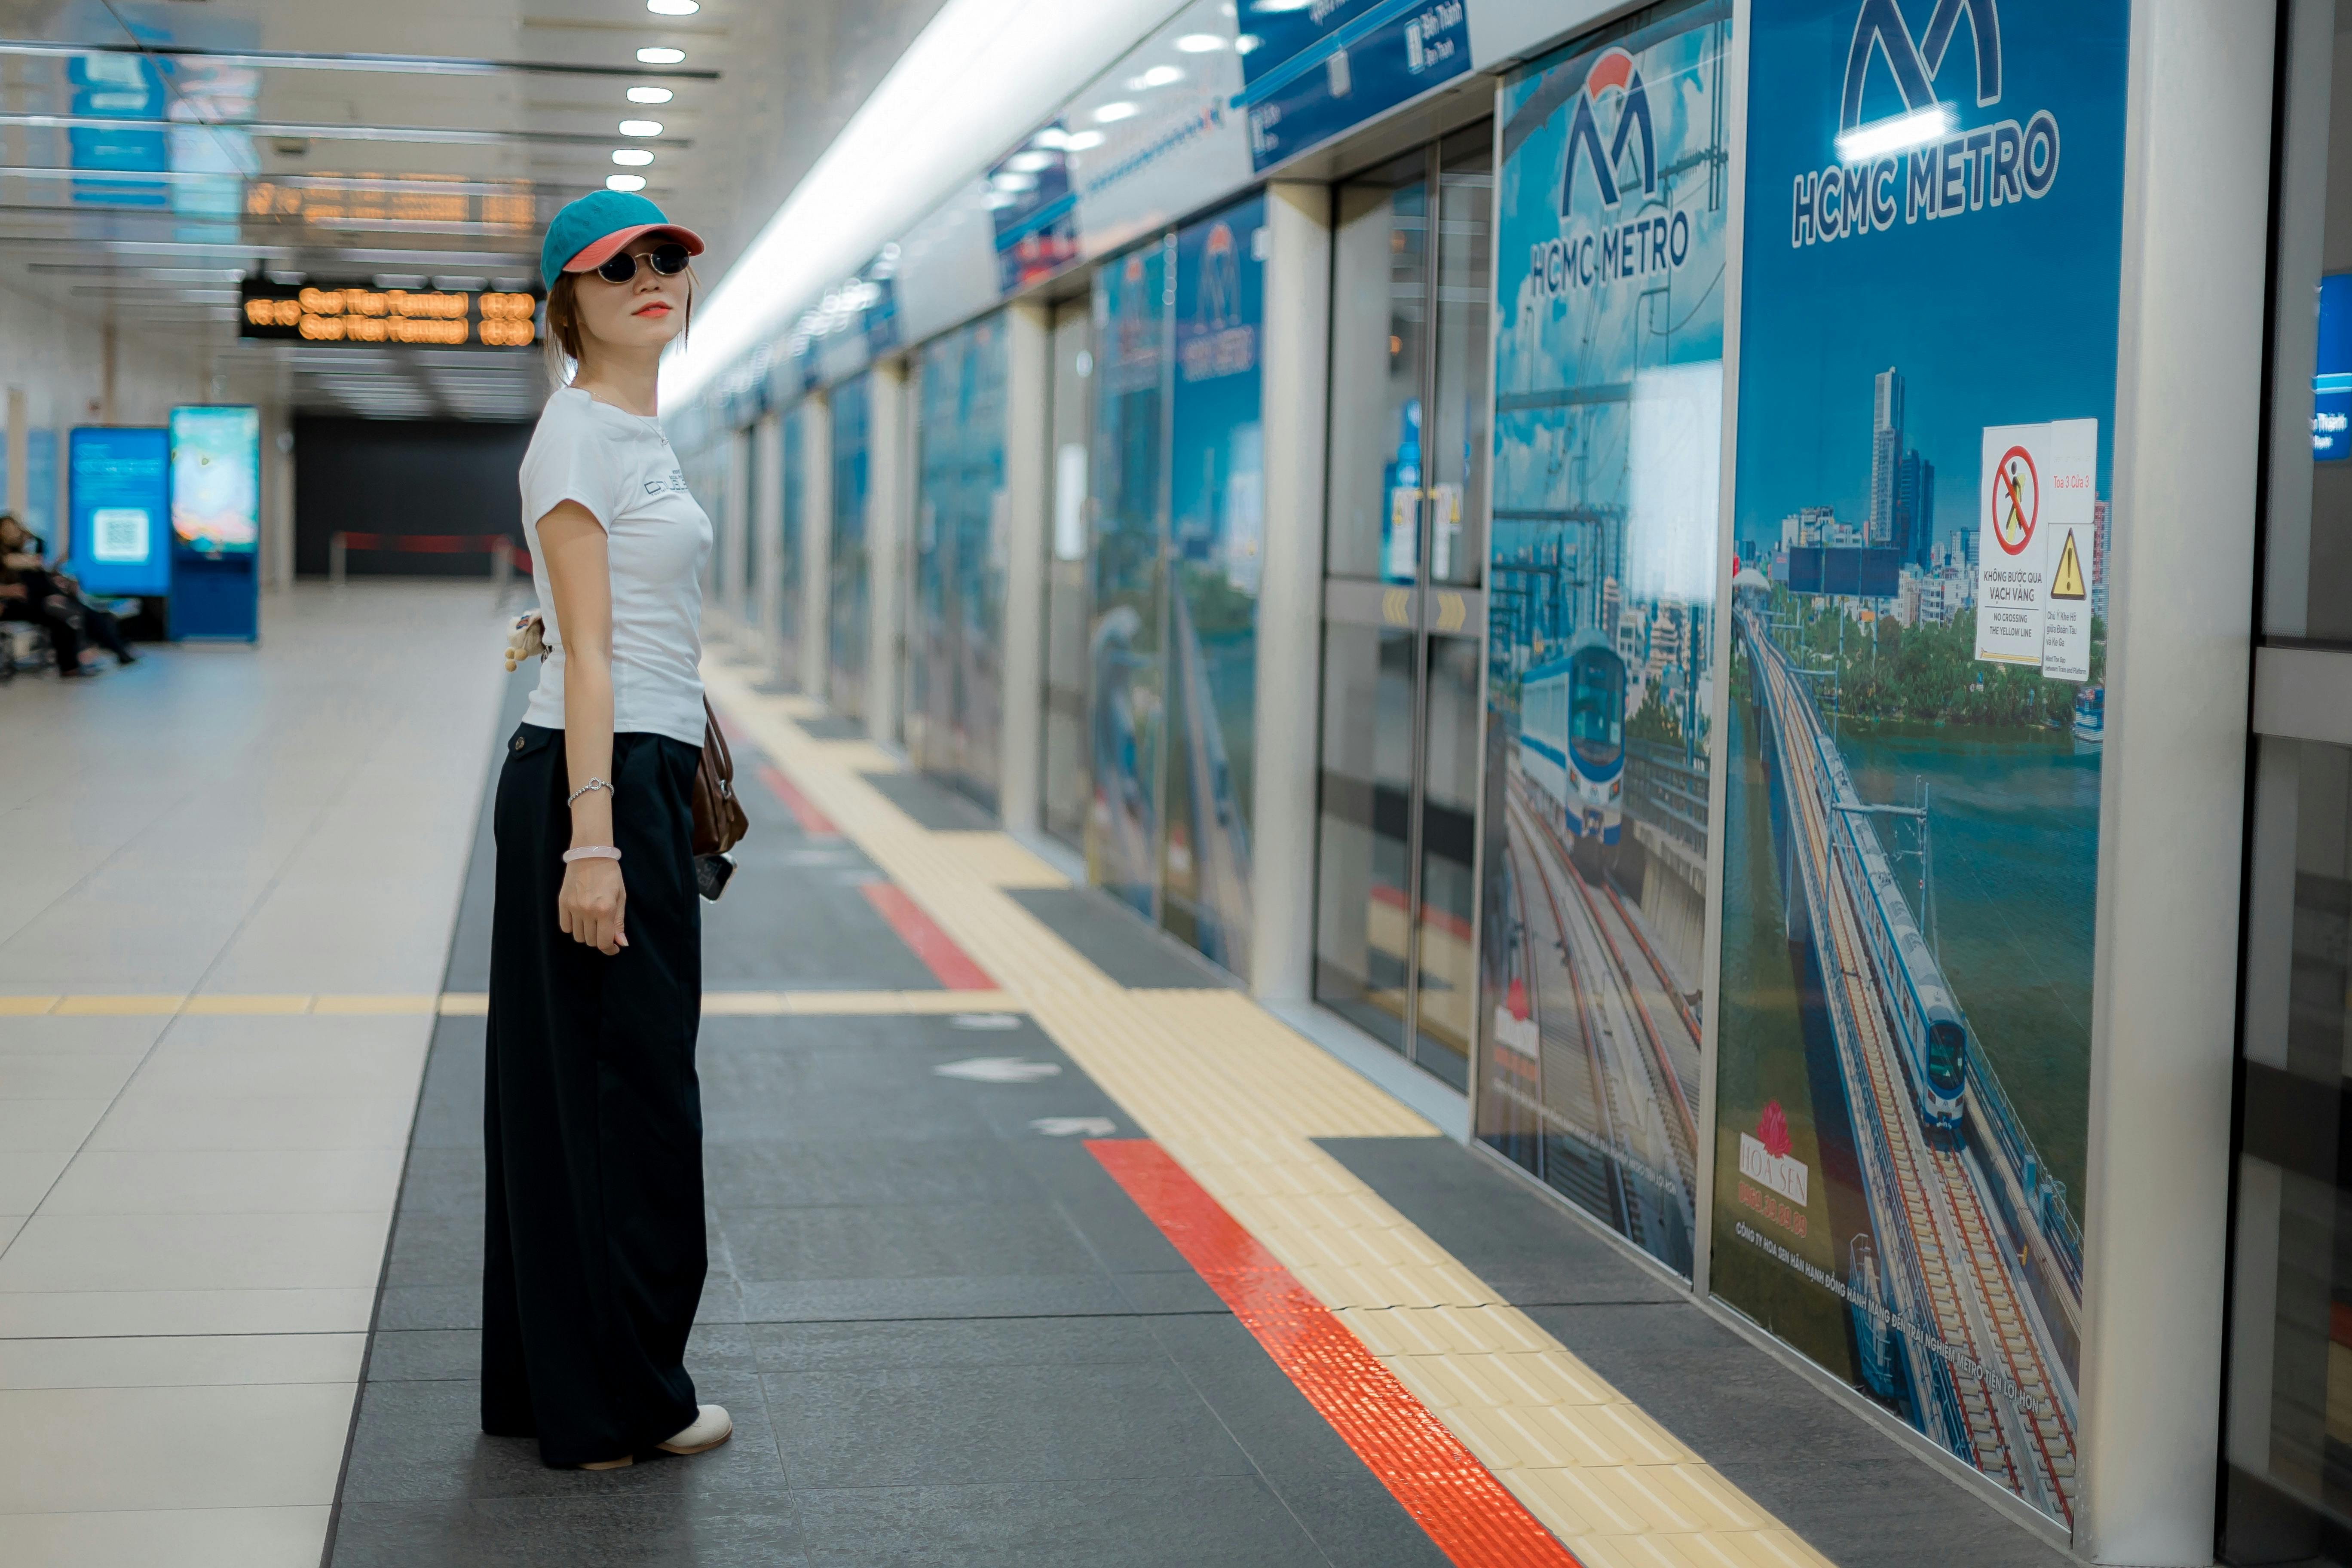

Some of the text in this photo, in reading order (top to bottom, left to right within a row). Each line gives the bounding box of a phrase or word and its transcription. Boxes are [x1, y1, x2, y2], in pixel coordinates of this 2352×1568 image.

[1792, 110, 2060, 248] HCMC METRO
[1531, 209, 1689, 296] HCMC METRO
[2054, 475, 2064, 488] Toa
[2065, 475, 2069, 488] 3
[2086, 475, 2089, 488] 3
[1984, 568, 2042, 584] KHÔNG BƯỚC QUA
[1990, 584, 2034, 604] VẠCH VÀNG
[1994, 613, 2027, 623] NO CROSSING
[2061, 612, 2069, 621] Khe
[1990, 626, 2032, 637] THE YELLOW LINE
[2046, 637, 2064, 647] và Ke Ga
[1742, 1143, 1805, 1201] HOA SEN
[1736, 1221, 1755, 1242] CÔNG
[1755, 1232, 1763, 1247] TY
[1763, 1237, 1777, 1257] HOA
[1778, 1246, 1789, 1264] SEN
[1805, 1262, 1824, 1284] HẠNH
[1847, 1287, 1867, 1310] HÀNH
[1868, 1299, 1890, 1323] MANG
[1892, 1311, 1906, 1333] ĐẾN
[1908, 1323, 1923, 1344] TRẢI
[1925, 1333, 1955, 1363] NGHIỆM
[1957, 1353, 1983, 1380] METRO
[2019, 1389, 2039, 1415] HƠN
